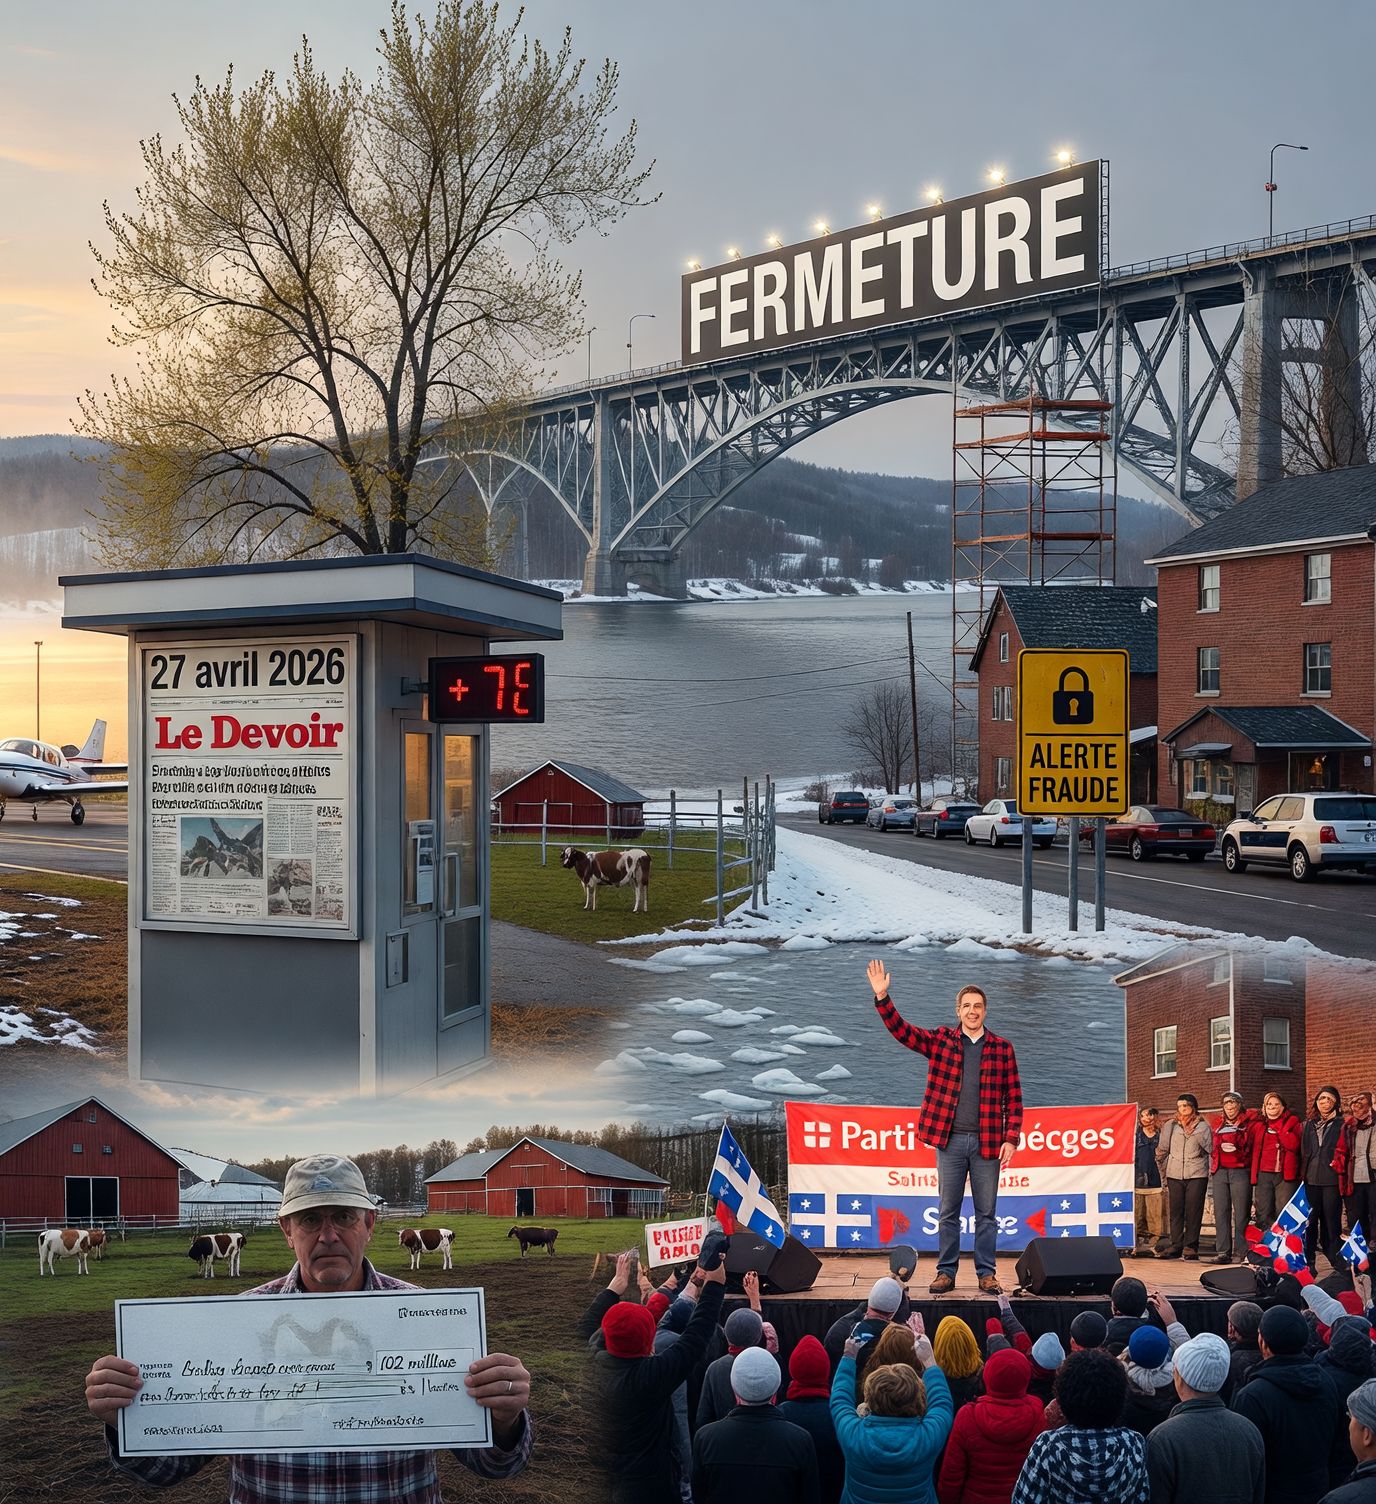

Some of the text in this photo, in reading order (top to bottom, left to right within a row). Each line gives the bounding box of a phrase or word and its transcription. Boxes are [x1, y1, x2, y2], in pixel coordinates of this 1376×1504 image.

[690, 177, 1084, 354] FERMETURE
[151, 648, 344, 689] 27 avril 2026
[155, 713, 343, 749] Le Devoir
[1030, 743, 1117, 769] ALERTE
[1029, 777, 1119, 803] FRAUDE
[842, 1122, 914, 1150] Parti
[381, 1355, 404, 1370] 102
